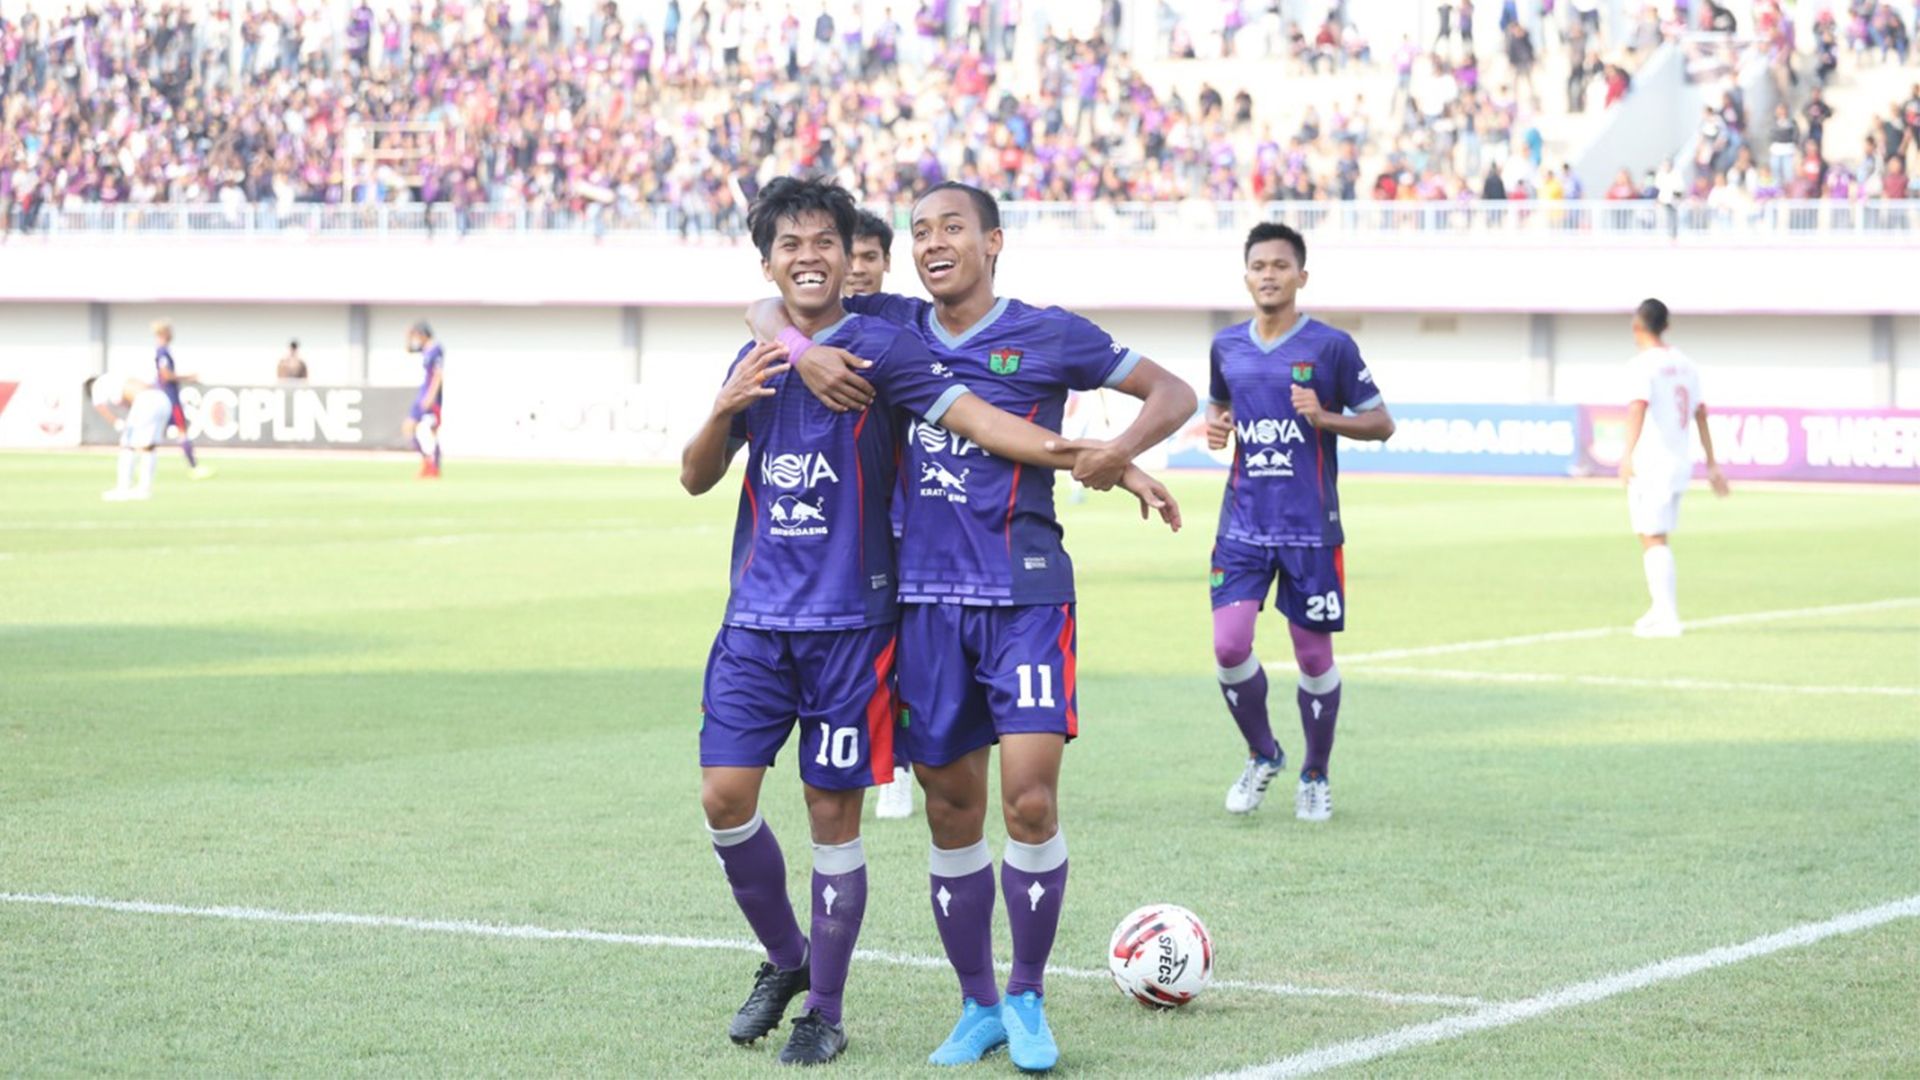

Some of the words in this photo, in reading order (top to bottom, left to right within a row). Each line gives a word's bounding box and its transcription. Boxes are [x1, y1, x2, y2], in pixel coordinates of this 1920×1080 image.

[167, 387, 362, 443] SCIPLINE
[1237, 418, 1305, 444] MOYA
[1306, 590, 1341, 621] 29
[1016, 664, 1055, 707] 11
[815, 722, 859, 768] 10
[1157, 935, 1173, 986] SPECS
